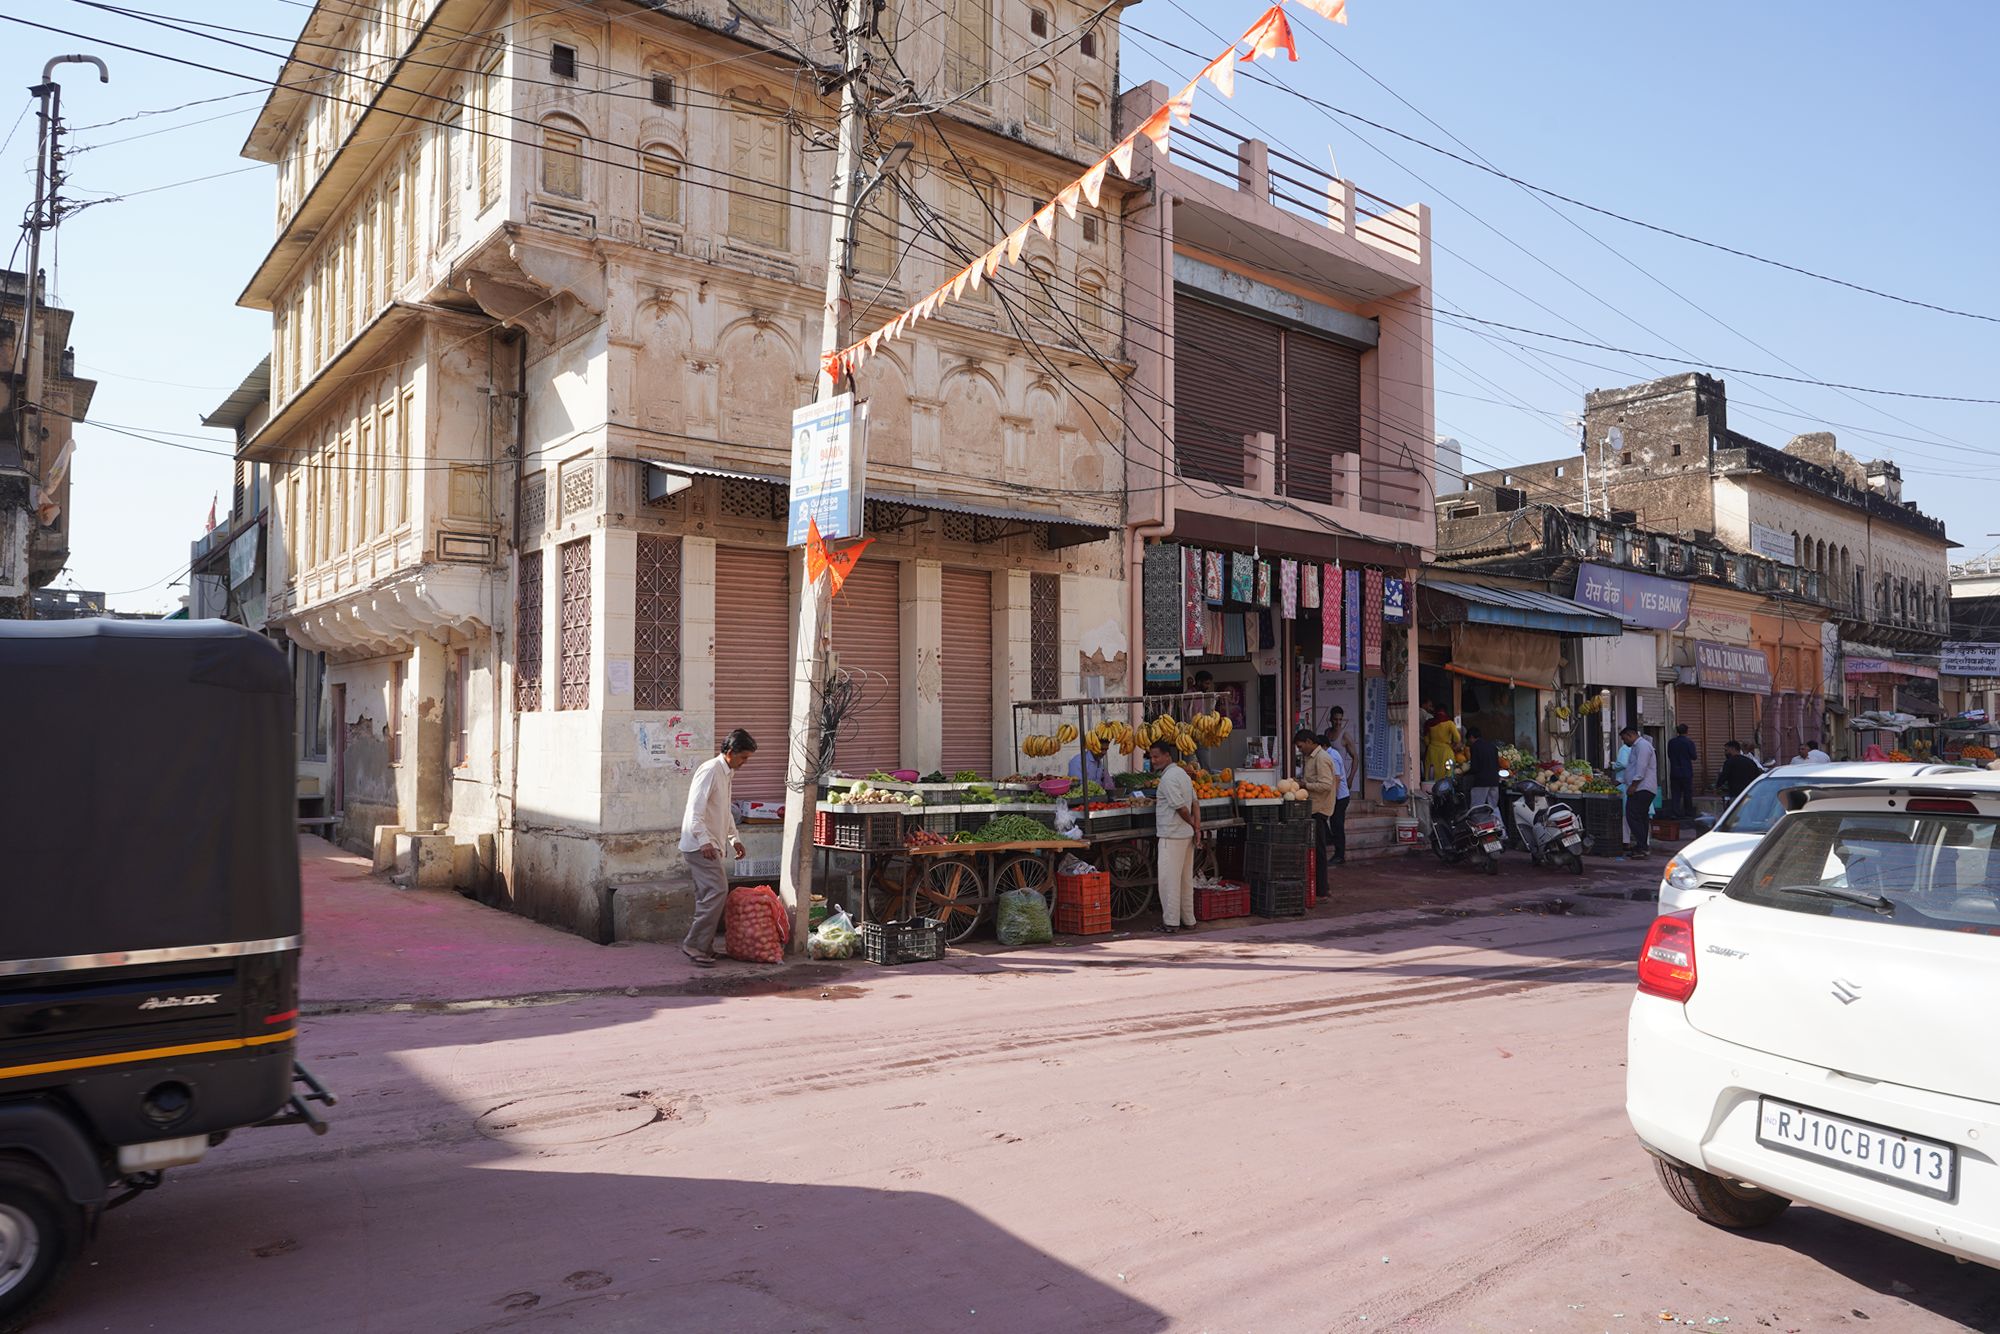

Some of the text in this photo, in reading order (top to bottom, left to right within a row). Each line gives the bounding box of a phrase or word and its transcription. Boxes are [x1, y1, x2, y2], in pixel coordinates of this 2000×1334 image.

[1585, 577, 1621, 605] येस बैंक
[1640, 591, 1683, 614] YES BANK
[1705, 647, 1765, 675] BLN ZAIKA POINT
[1705, 944, 1749, 960] SWIFT
[1778, 1111, 1943, 1180] RJ10CB1013
